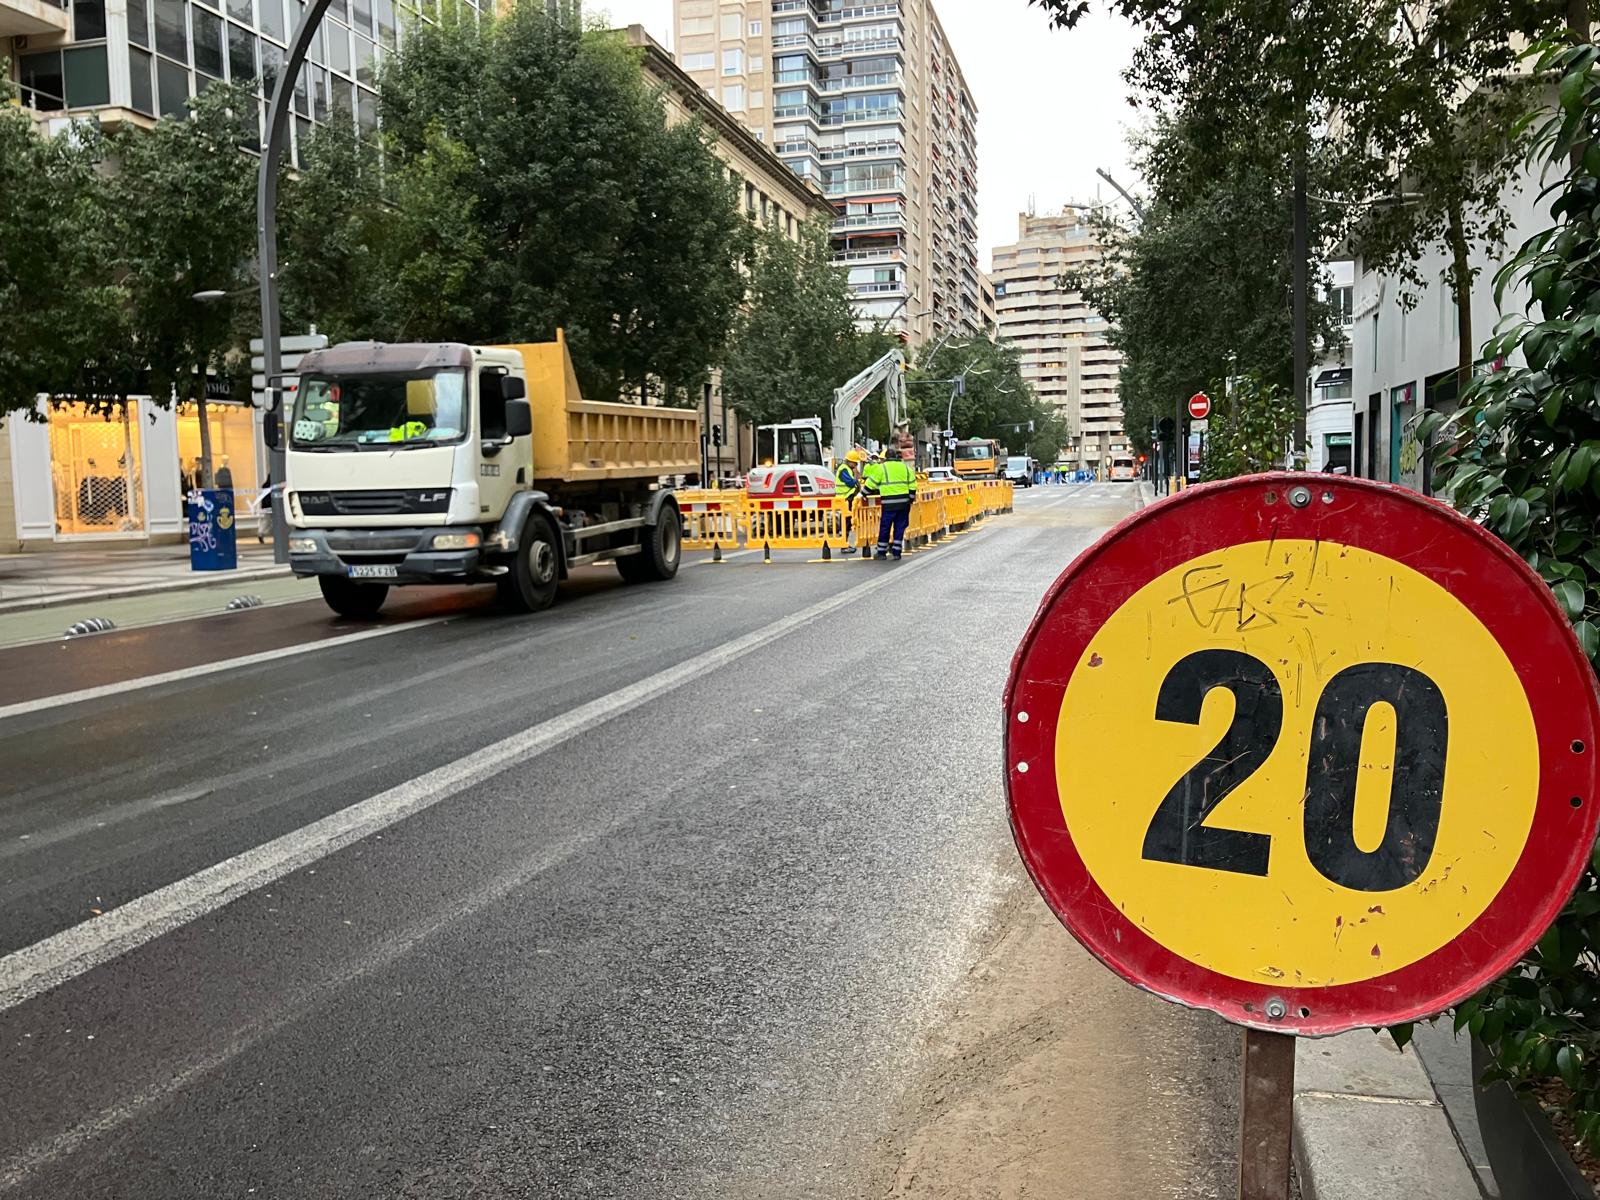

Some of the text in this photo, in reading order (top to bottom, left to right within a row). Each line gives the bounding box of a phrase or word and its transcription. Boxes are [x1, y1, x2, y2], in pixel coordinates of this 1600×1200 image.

[206, 382, 230, 394] YSHO
[301, 496, 329, 504] DAF
[419, 493, 446, 502] LF
[1141, 649, 1449, 892] 20
